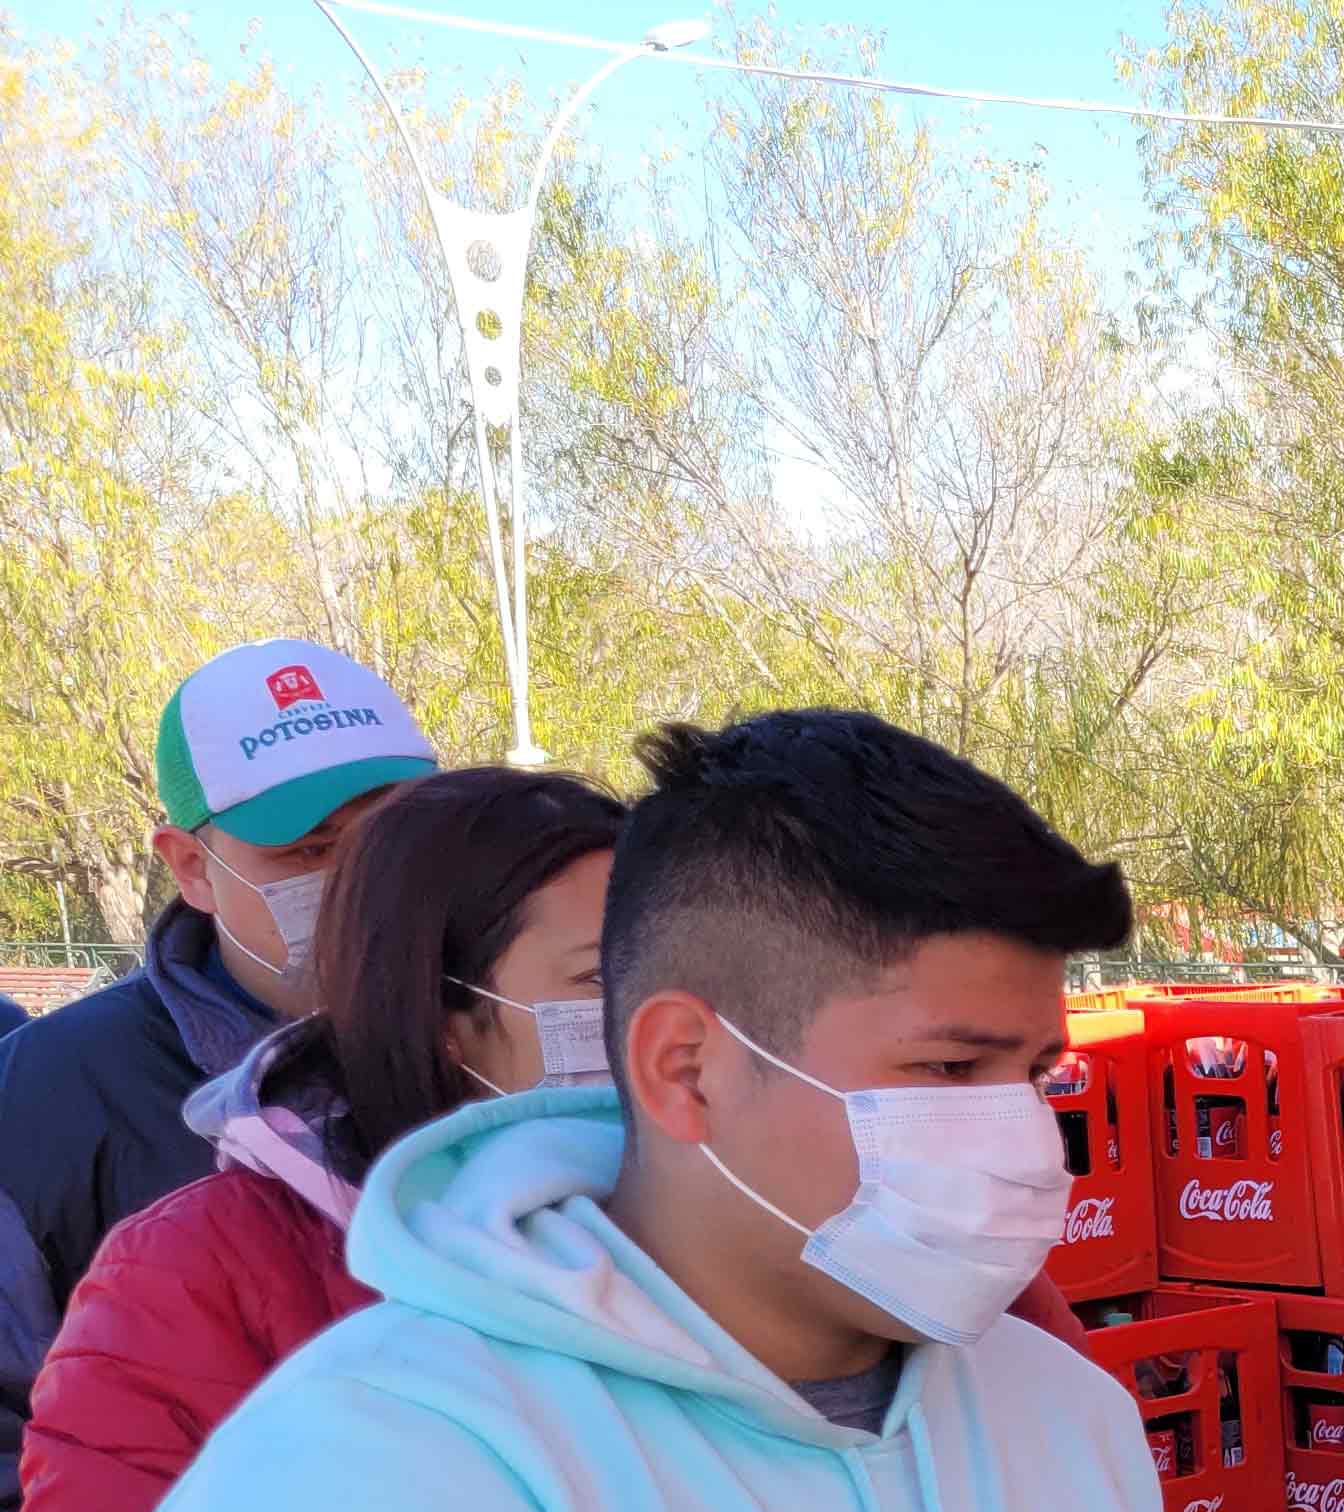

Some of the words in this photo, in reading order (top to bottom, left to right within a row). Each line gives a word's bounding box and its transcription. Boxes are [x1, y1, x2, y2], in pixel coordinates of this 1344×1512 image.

[240, 708, 384, 761] POTOSINA
[1063, 1197, 1115, 1244] -Cola
[1180, 1179, 1273, 1221] Coca-Cola
